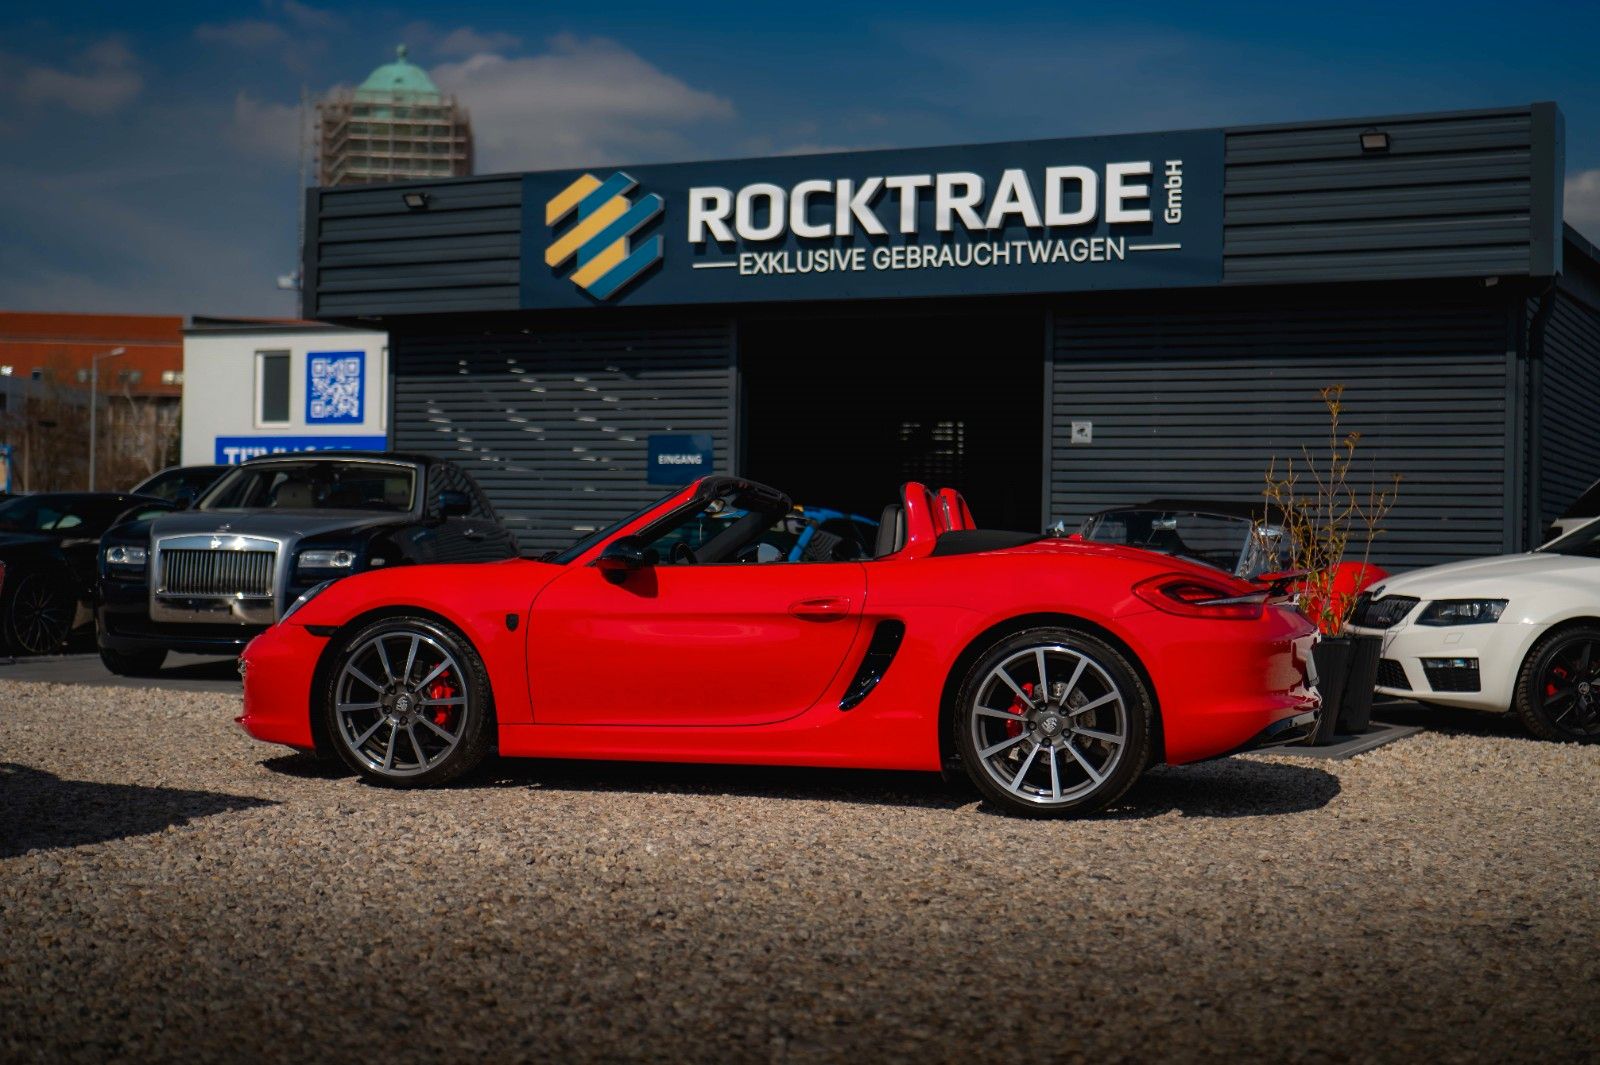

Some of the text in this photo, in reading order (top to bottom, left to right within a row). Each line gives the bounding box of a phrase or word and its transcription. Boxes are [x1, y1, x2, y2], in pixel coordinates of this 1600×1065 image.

[688, 160, 1153, 243] ROCKTRADE
[1164, 160, 1183, 224] GmbH
[739, 236, 1125, 275] EXKLUSIVE GEBRAUCHTWAGEN
[658, 454, 702, 465] EINGANG
